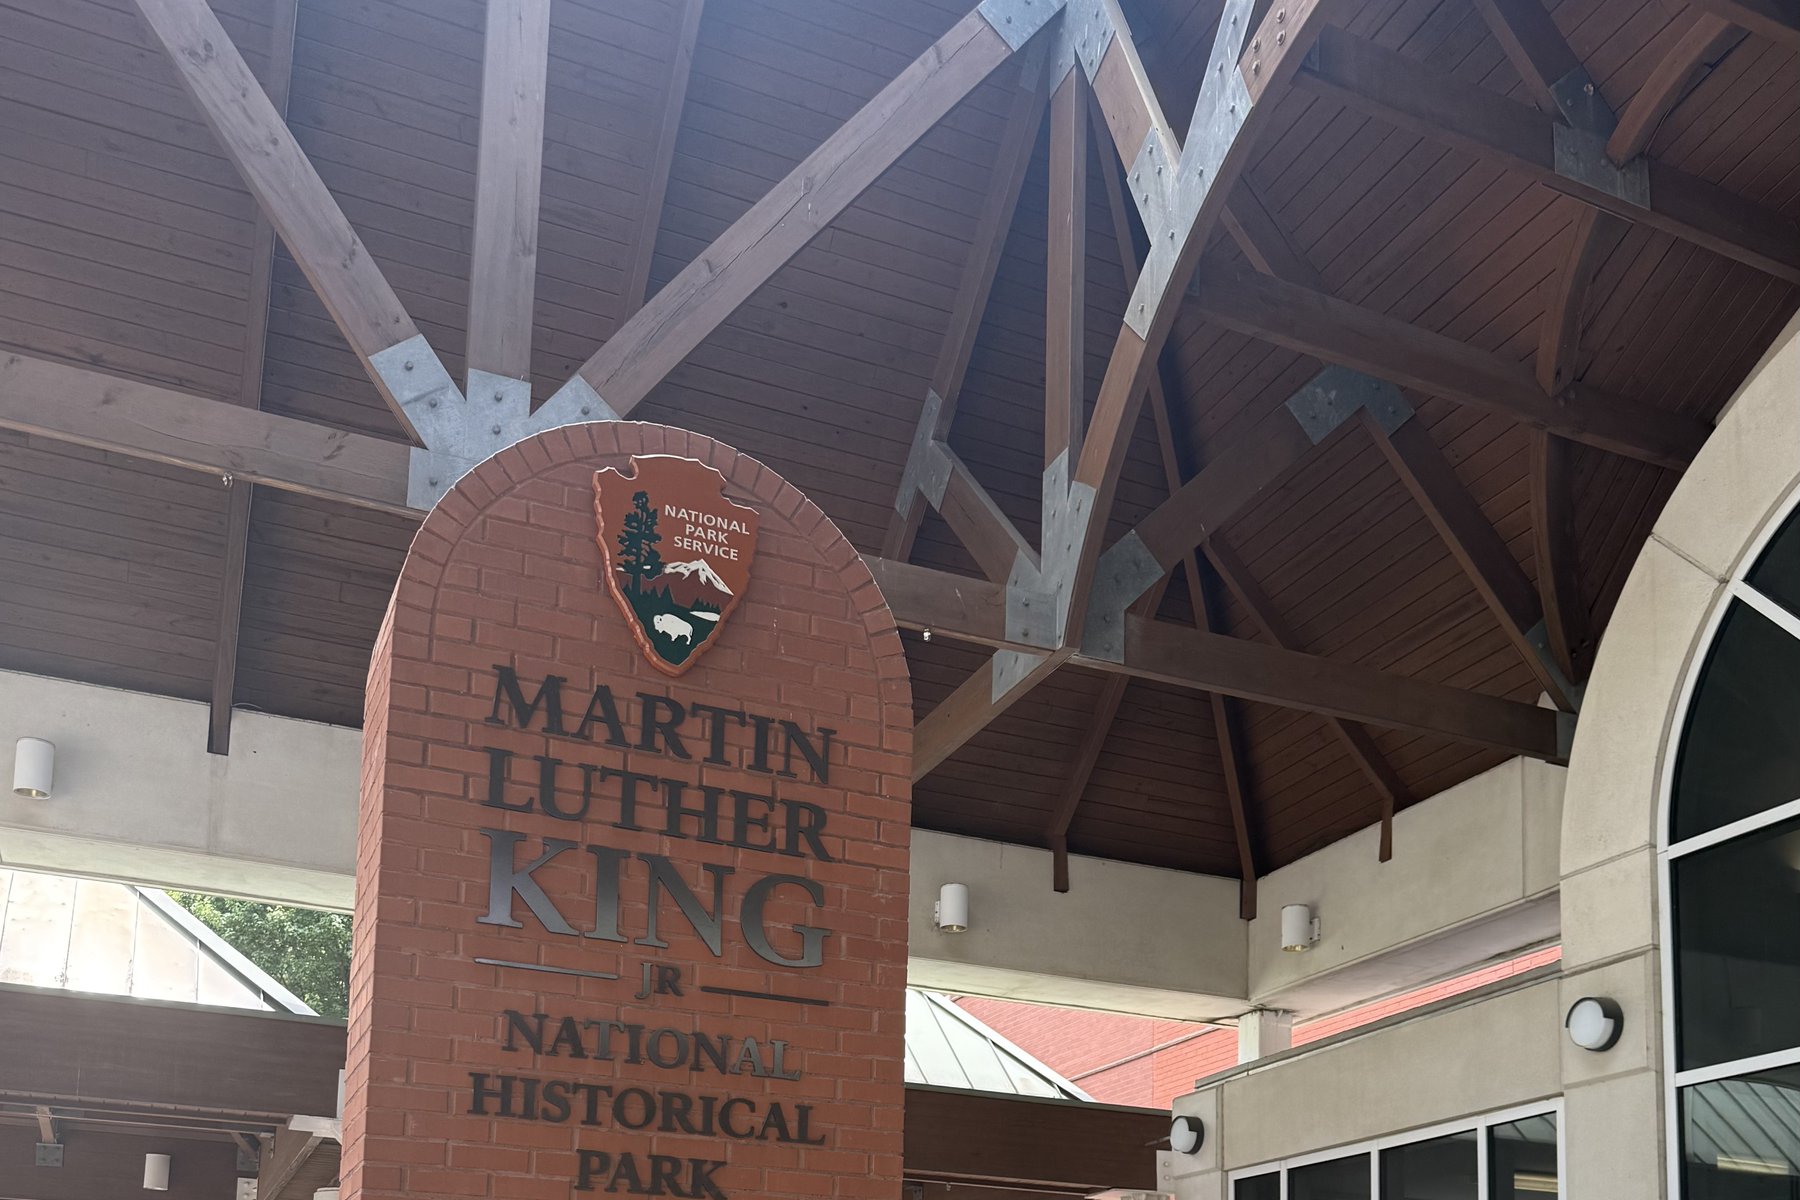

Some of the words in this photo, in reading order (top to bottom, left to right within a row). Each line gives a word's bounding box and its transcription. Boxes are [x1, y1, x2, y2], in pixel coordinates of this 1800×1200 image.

[663, 504, 750, 536] NATIONAL
[673, 535, 739, 561] SERVICE
[685, 523, 729, 545] PARK
[484, 664, 837, 785] MARTIN
[481, 746, 834, 862] LUTHER
[476, 828, 832, 968] KING
[634, 961, 685, 1000] JR
[501, 1009, 801, 1082] NATIONAL
[467, 1072, 827, 1146] HISTORICAL
[574, 1148, 729, 1200] PARK
